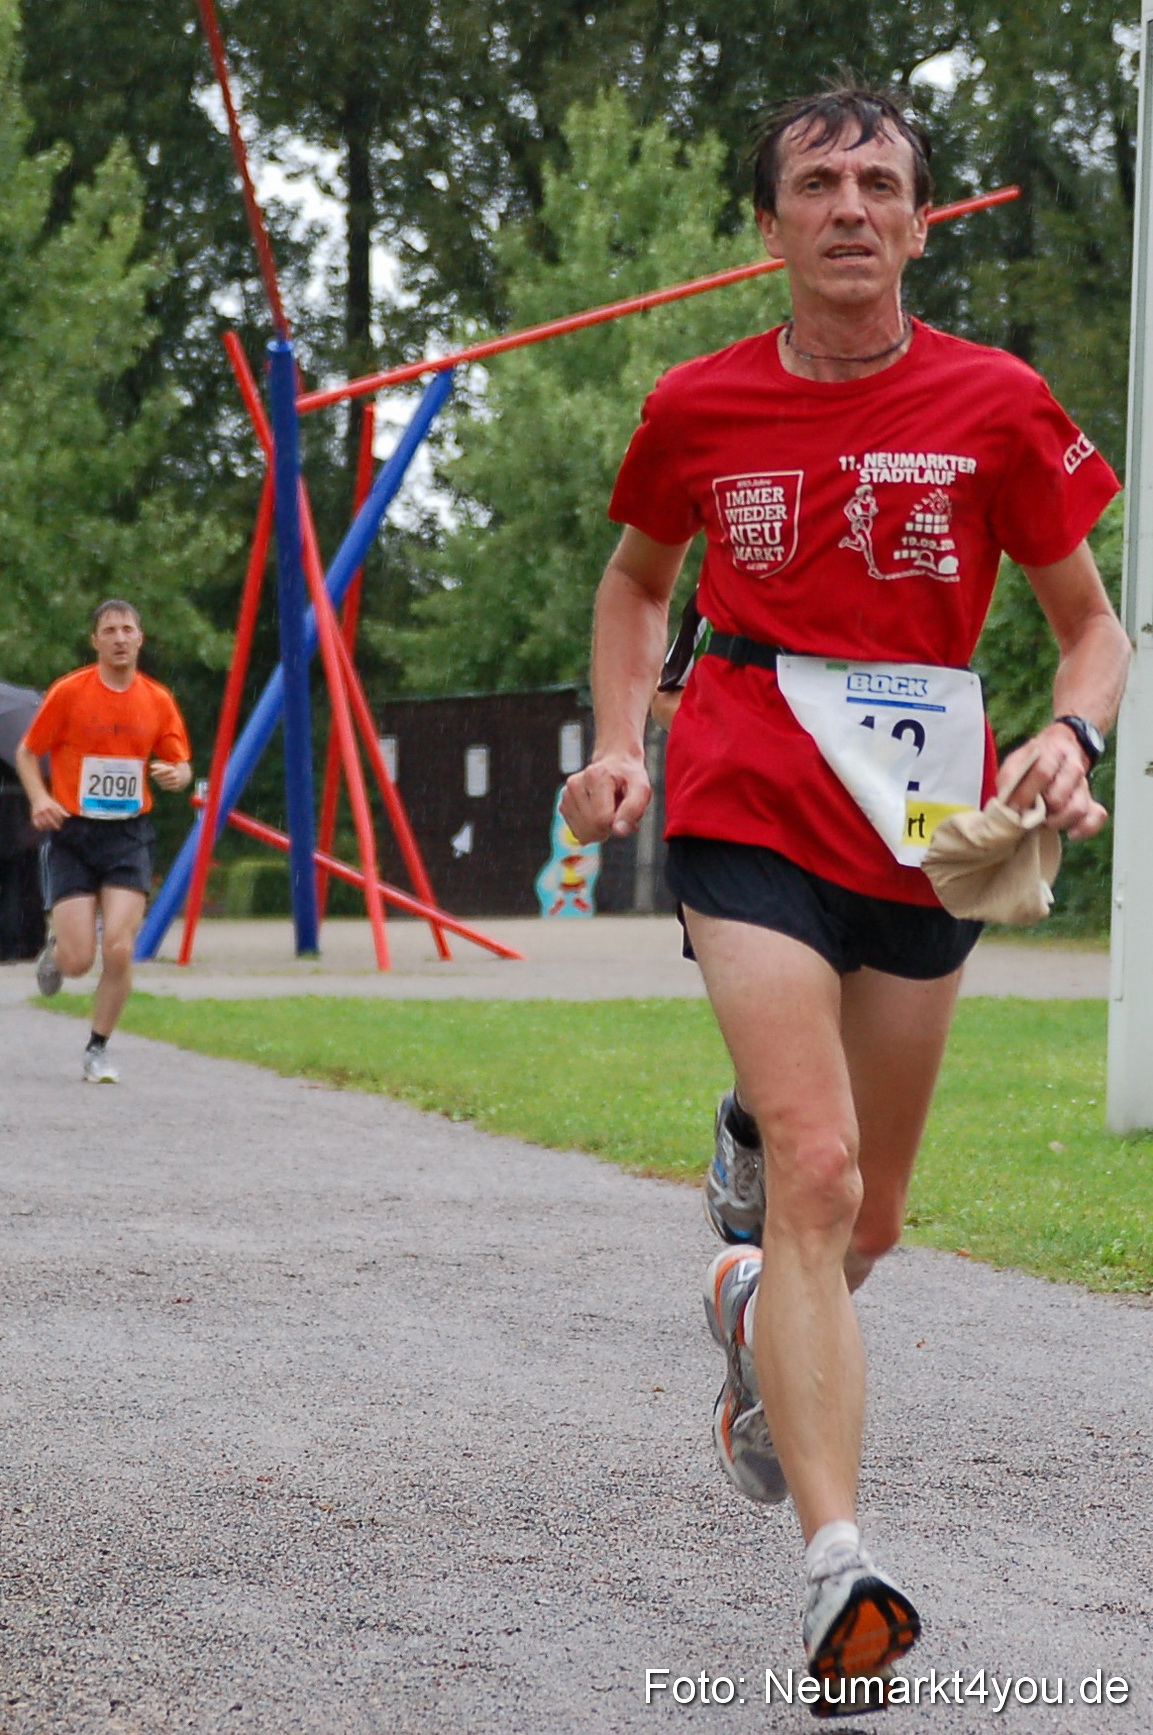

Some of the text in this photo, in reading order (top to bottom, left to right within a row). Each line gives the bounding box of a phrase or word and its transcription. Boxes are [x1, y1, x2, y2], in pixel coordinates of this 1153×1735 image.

[839, 452, 977, 474] 11. NEUMARKTER
[859, 468, 956, 486] STADTLAUF
[725, 486, 785, 508] IMMER
[724, 503, 788, 524] WIEDER
[729, 521, 783, 546] NEU
[734, 546, 785, 562] MARKT
[847, 672, 928, 697] BOCK
[88, 774, 137, 797] 2090
